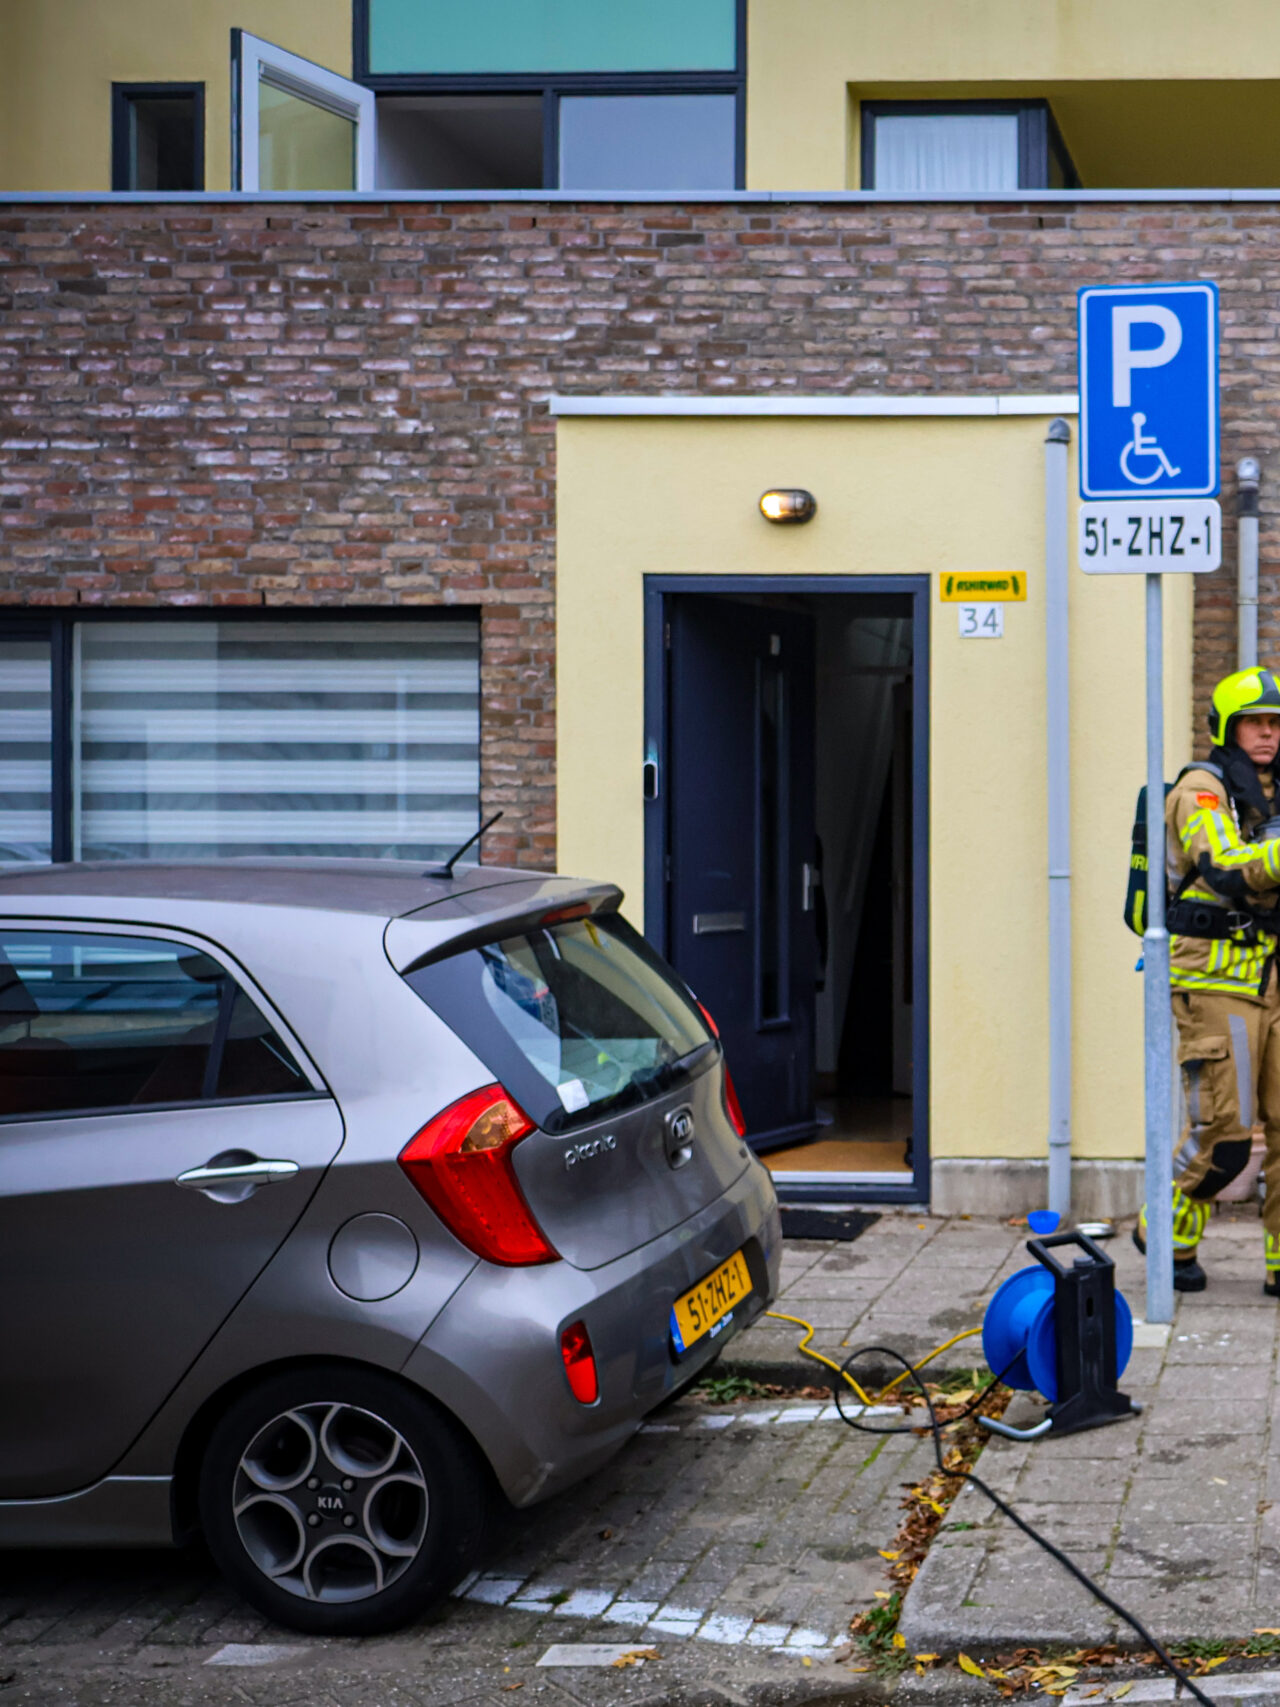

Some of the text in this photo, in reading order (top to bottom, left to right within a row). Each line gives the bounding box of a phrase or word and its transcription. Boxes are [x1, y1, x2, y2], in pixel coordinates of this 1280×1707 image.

[1112, 305, 1183, 407] P
[1085, 515, 1211, 556] 51-ZHZ-1
[963, 608, 999, 633] 34
[565, 1134, 617, 1170] picanto
[688, 1260, 745, 1332] 51-ZHZ-1
[318, 1496, 343, 1509] KIA
